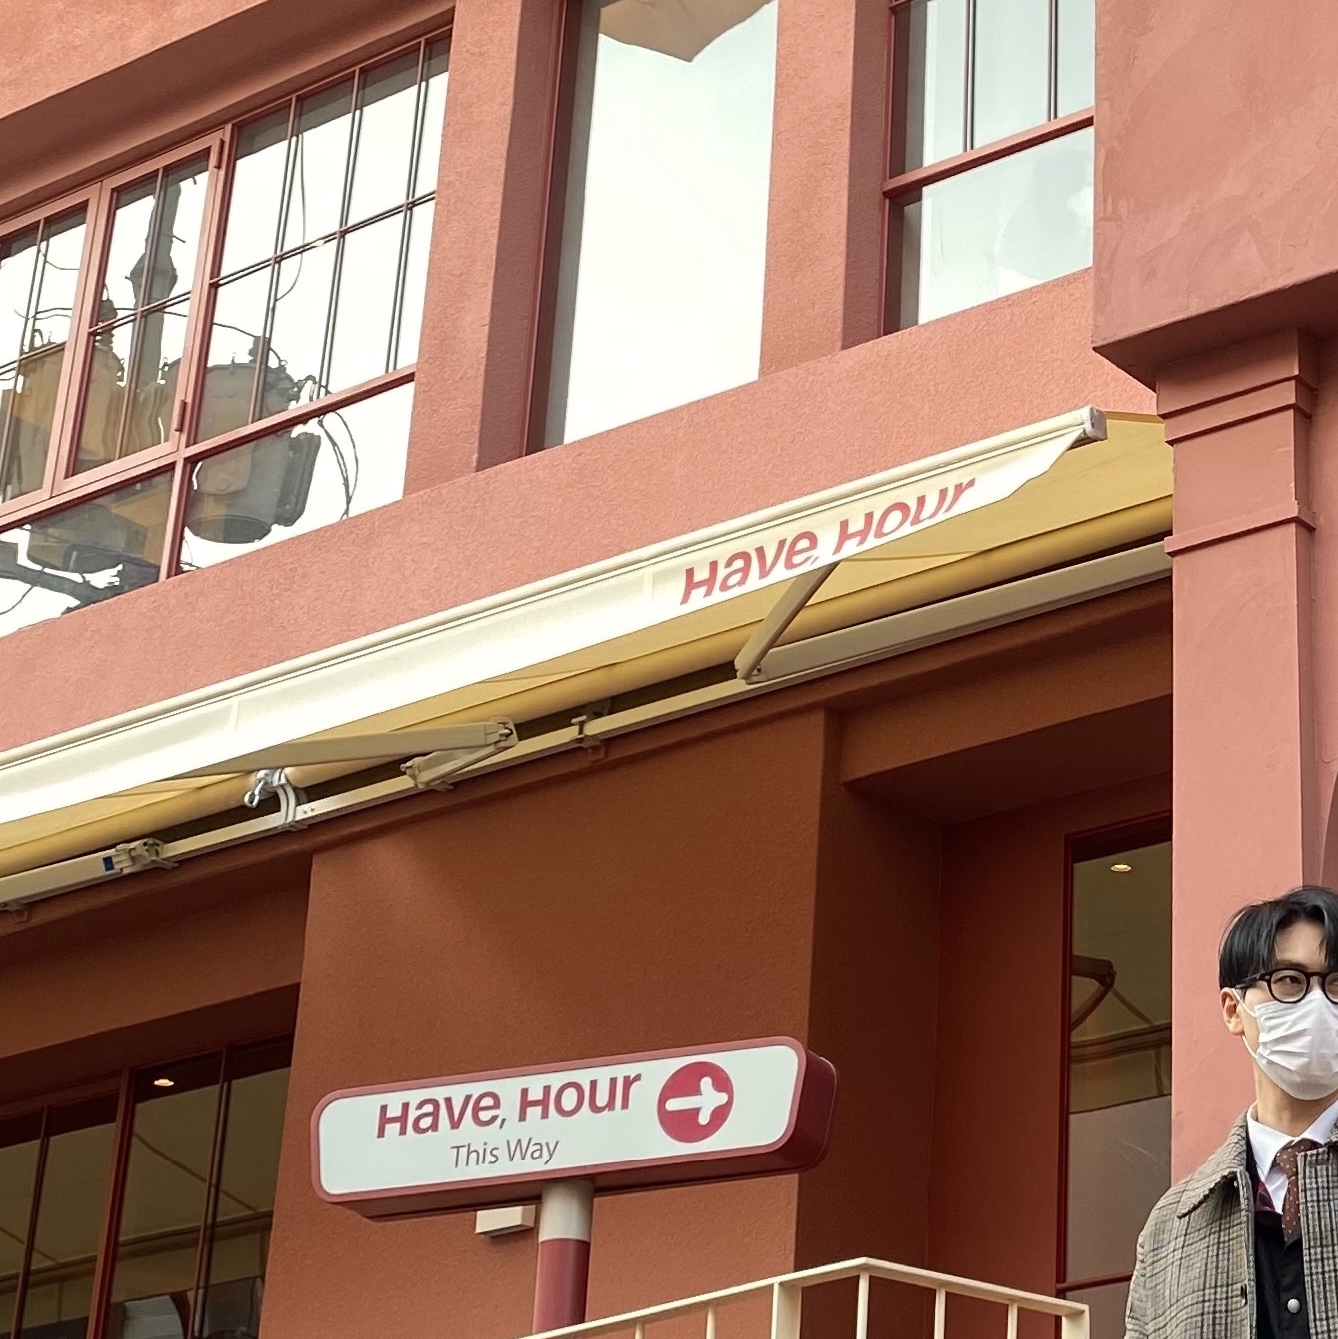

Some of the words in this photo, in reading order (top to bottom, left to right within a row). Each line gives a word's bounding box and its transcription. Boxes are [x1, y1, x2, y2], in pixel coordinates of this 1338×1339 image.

[832, 478, 976, 556] Hour
[377, 1091, 507, 1139] Have,
[518, 1073, 642, 1122] Hour
[450, 1143, 500, 1168] This
[506, 1137, 560, 1164] Way
